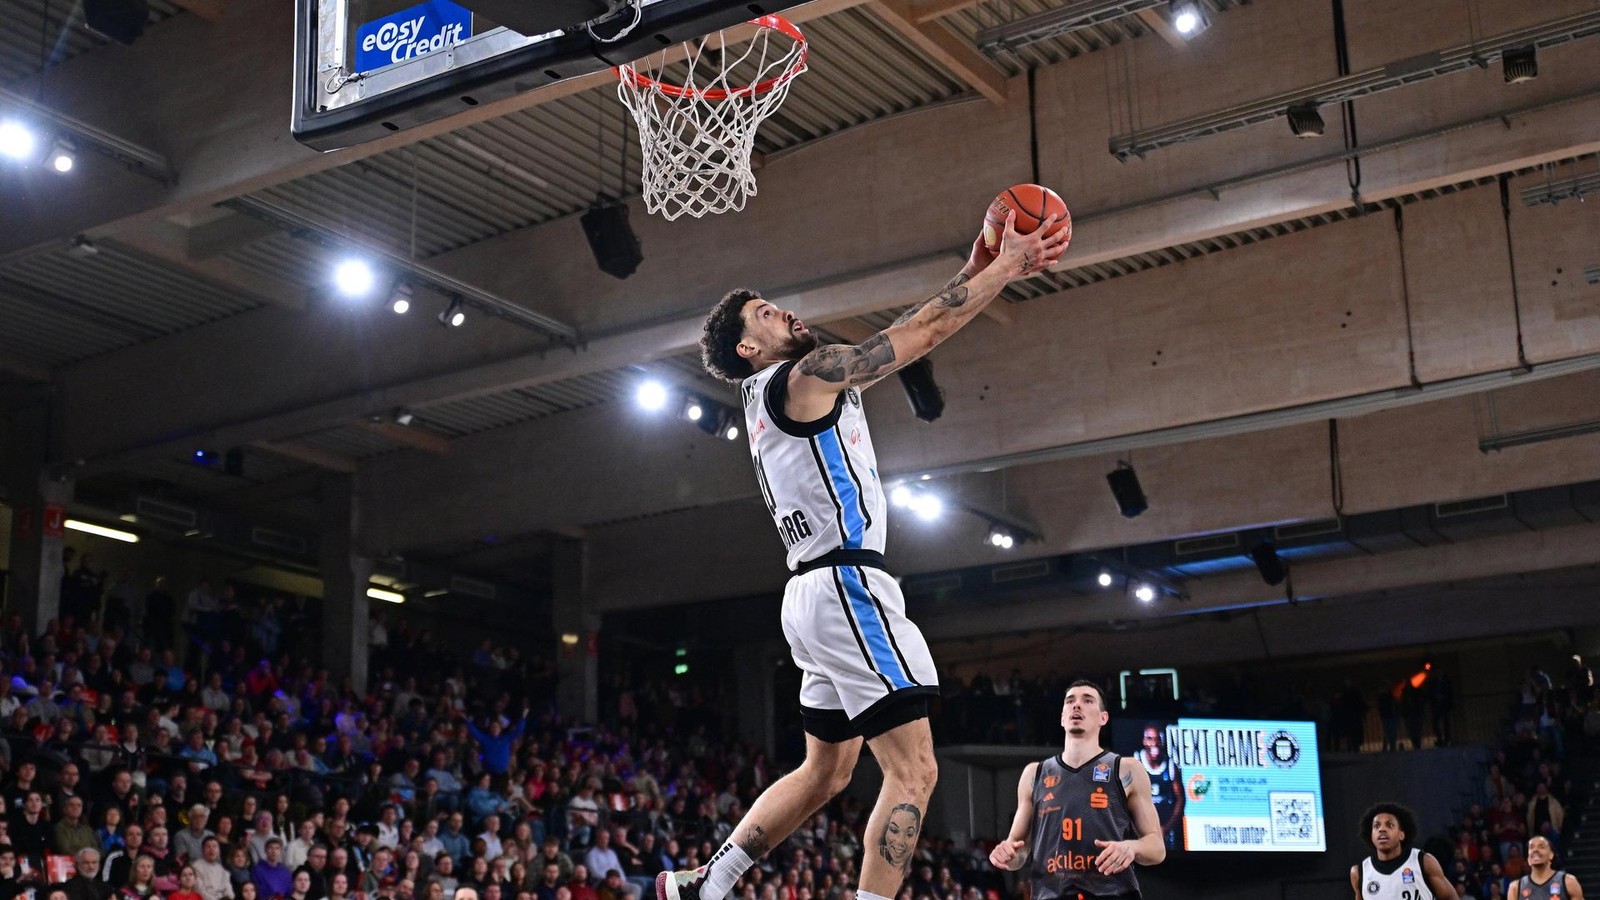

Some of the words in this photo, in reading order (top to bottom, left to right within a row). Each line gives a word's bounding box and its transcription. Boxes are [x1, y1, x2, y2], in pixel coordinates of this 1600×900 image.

[391, 22, 465, 64] Credit
[1166, 725, 1214, 767] NEXT
[1215, 729, 1266, 767] GAME
[1062, 817, 1082, 841] 91
